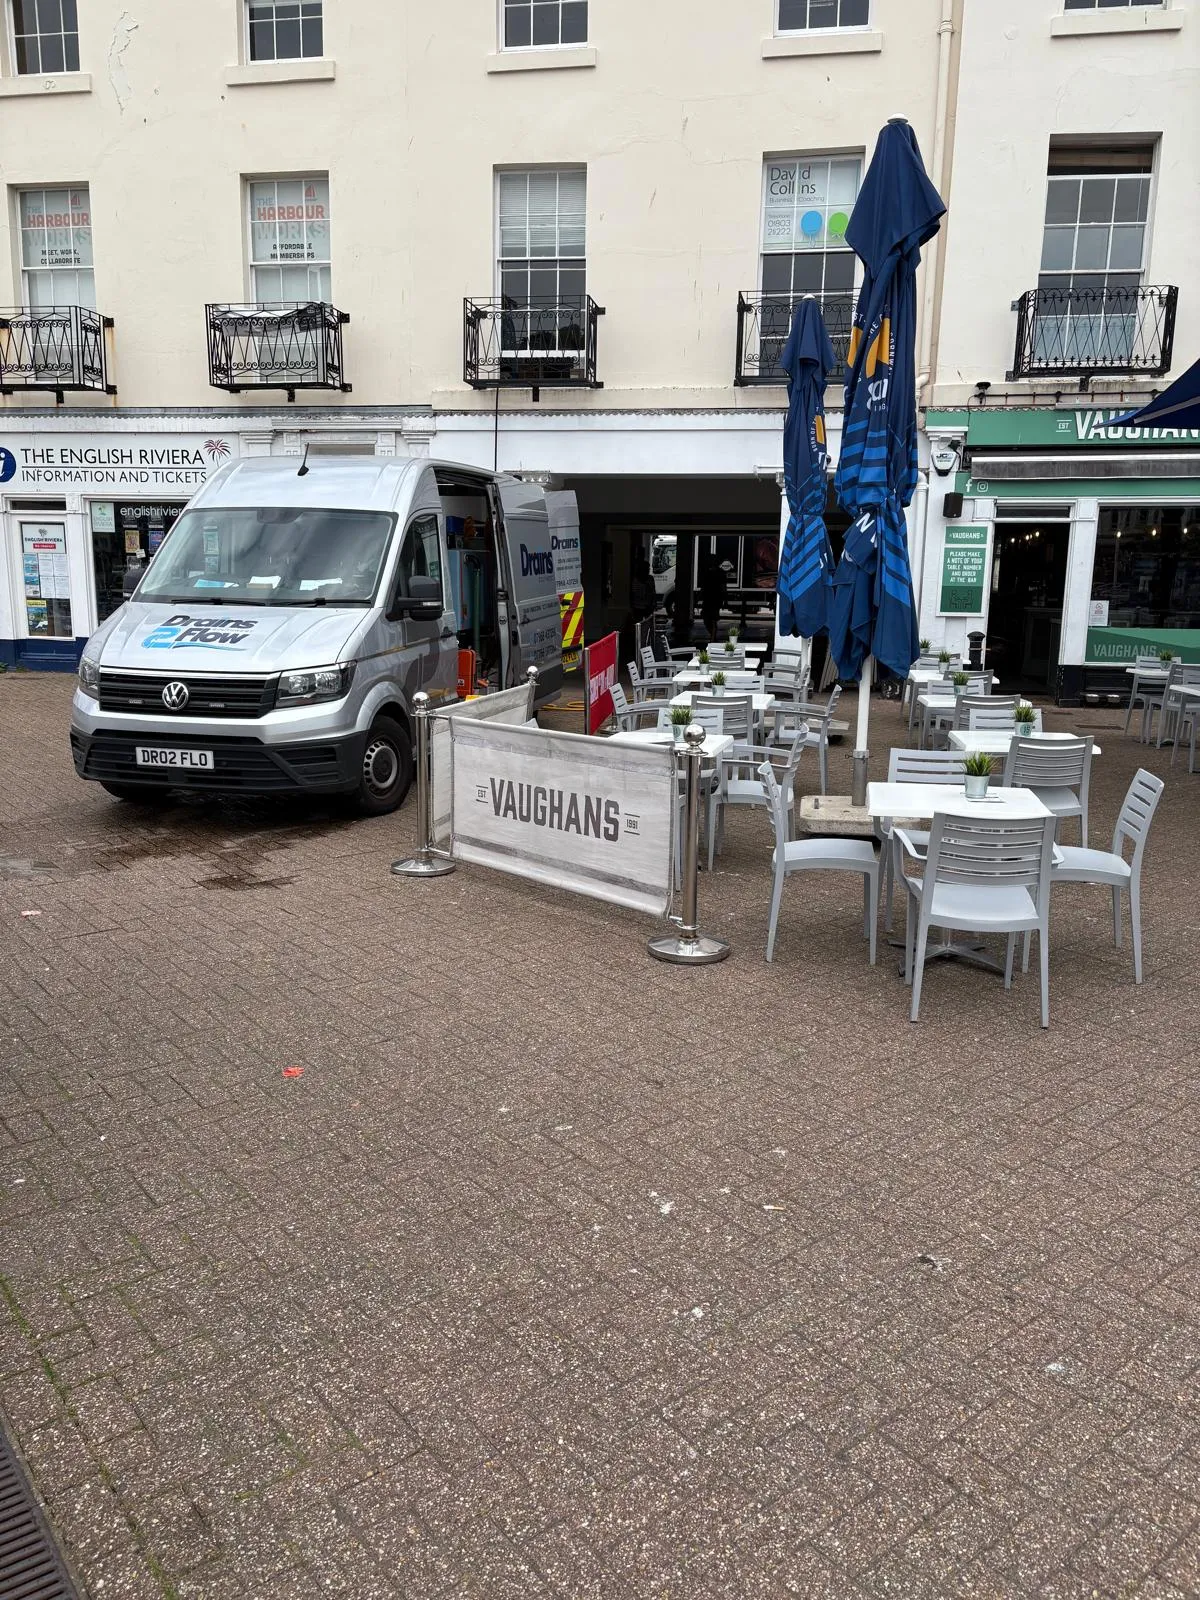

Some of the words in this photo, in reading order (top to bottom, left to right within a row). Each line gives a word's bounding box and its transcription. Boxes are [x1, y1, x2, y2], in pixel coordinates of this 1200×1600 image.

[771, 165, 811, 180] Davd
[770, 181, 816, 195] Collns
[257, 205, 325, 220] HARBOUR
[27, 213, 90, 228] HARBOUR
[21, 449, 57, 464] THE
[61, 449, 133, 464] ENGLISH
[139, 449, 205, 465] RIVIERA
[22, 470, 116, 482] INFORMATION
[119, 471, 150, 483] AND
[152, 471, 207, 484] TICKETS
[551, 535, 579, 550] Drains
[520, 543, 553, 577] Drains
[160, 615, 258, 629] Drains
[173, 627, 250, 644] Flow
[1093, 643, 1158, 658] VAUGHANS
[142, 750, 177, 765] DR02
[181, 751, 208, 767] FLO
[477, 790, 486, 798] EST
[489, 777, 620, 842] VAUGHANS
[627, 818, 639, 829] 1991
